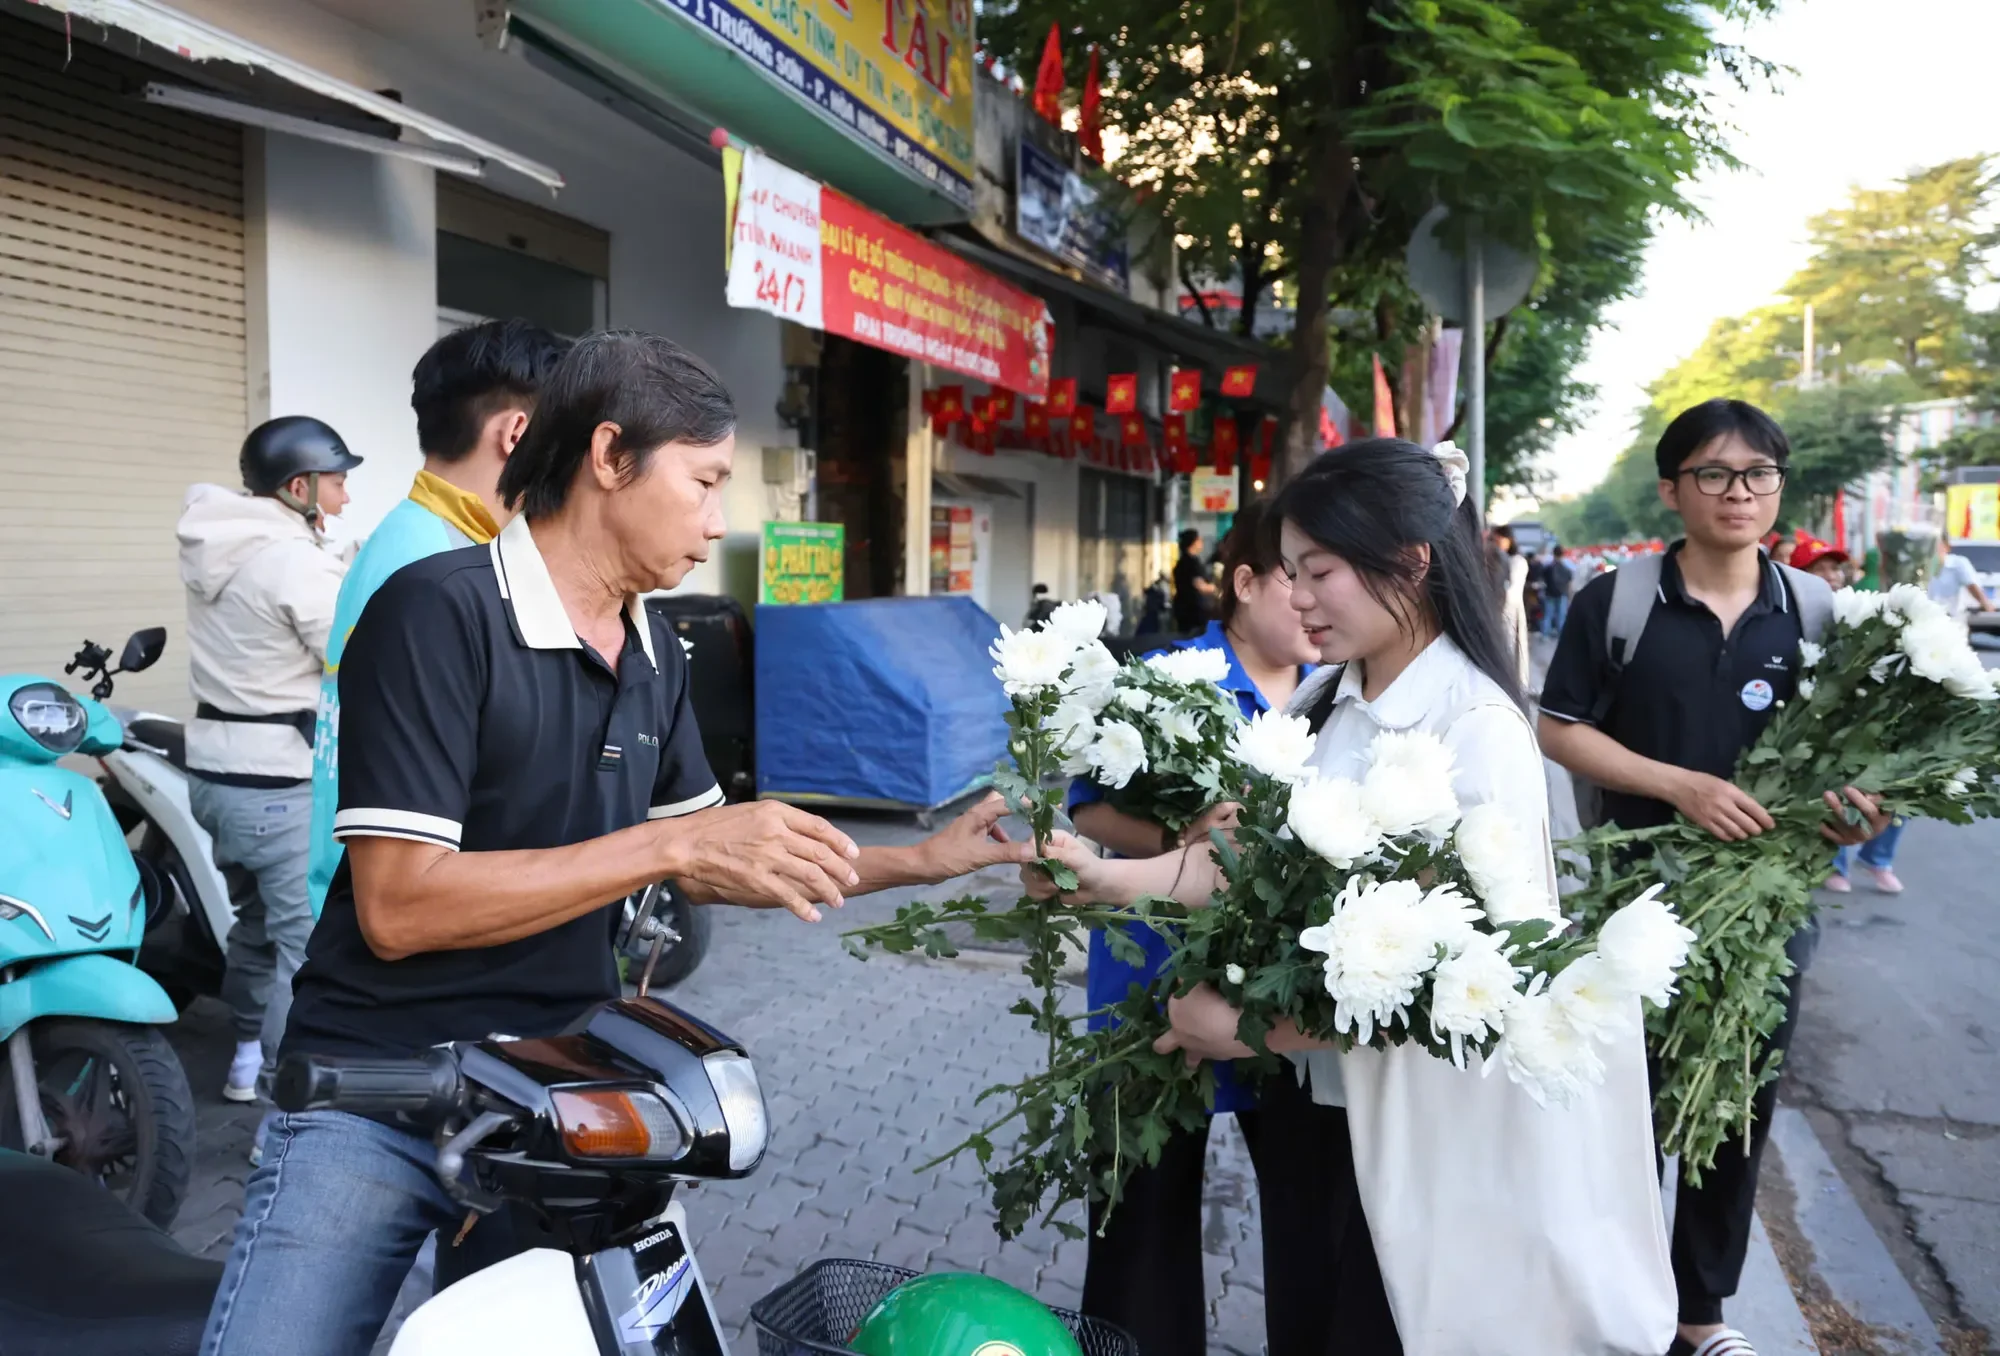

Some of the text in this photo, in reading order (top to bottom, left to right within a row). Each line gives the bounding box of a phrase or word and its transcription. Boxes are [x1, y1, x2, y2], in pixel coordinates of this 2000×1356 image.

[754, 259, 806, 313] 24/7
[633, 1229, 673, 1252] HONDA
[631, 1253, 689, 1304] Dream
